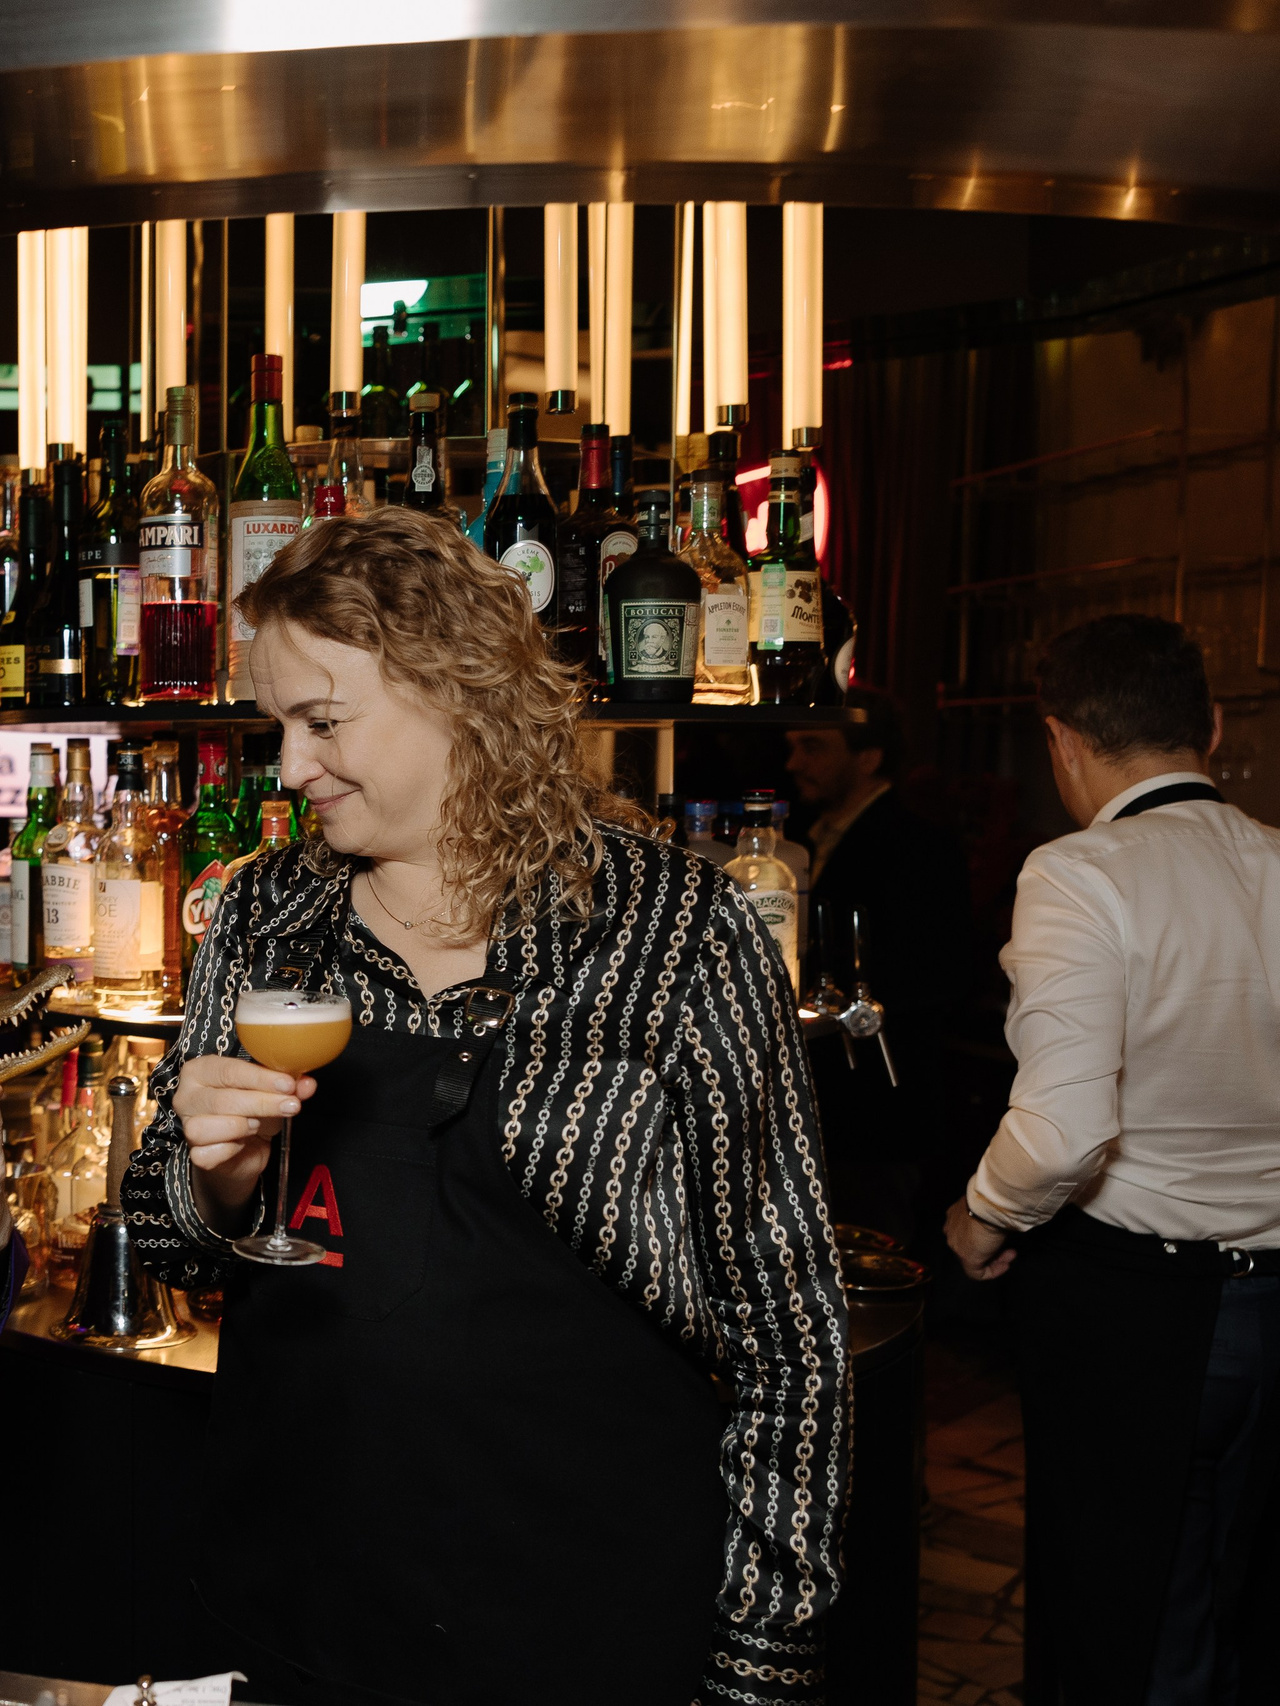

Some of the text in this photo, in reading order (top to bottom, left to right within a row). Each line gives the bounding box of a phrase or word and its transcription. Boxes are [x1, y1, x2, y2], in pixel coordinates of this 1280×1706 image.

[246, 522, 300, 535] LUXARDO
[78, 550, 102, 562] EPE
[630, 608, 680, 617] BOTUCAL
[707, 601, 732, 615] APPLETON
[46, 908, 60, 925] 13
[287, 1164, 344, 1237] A
